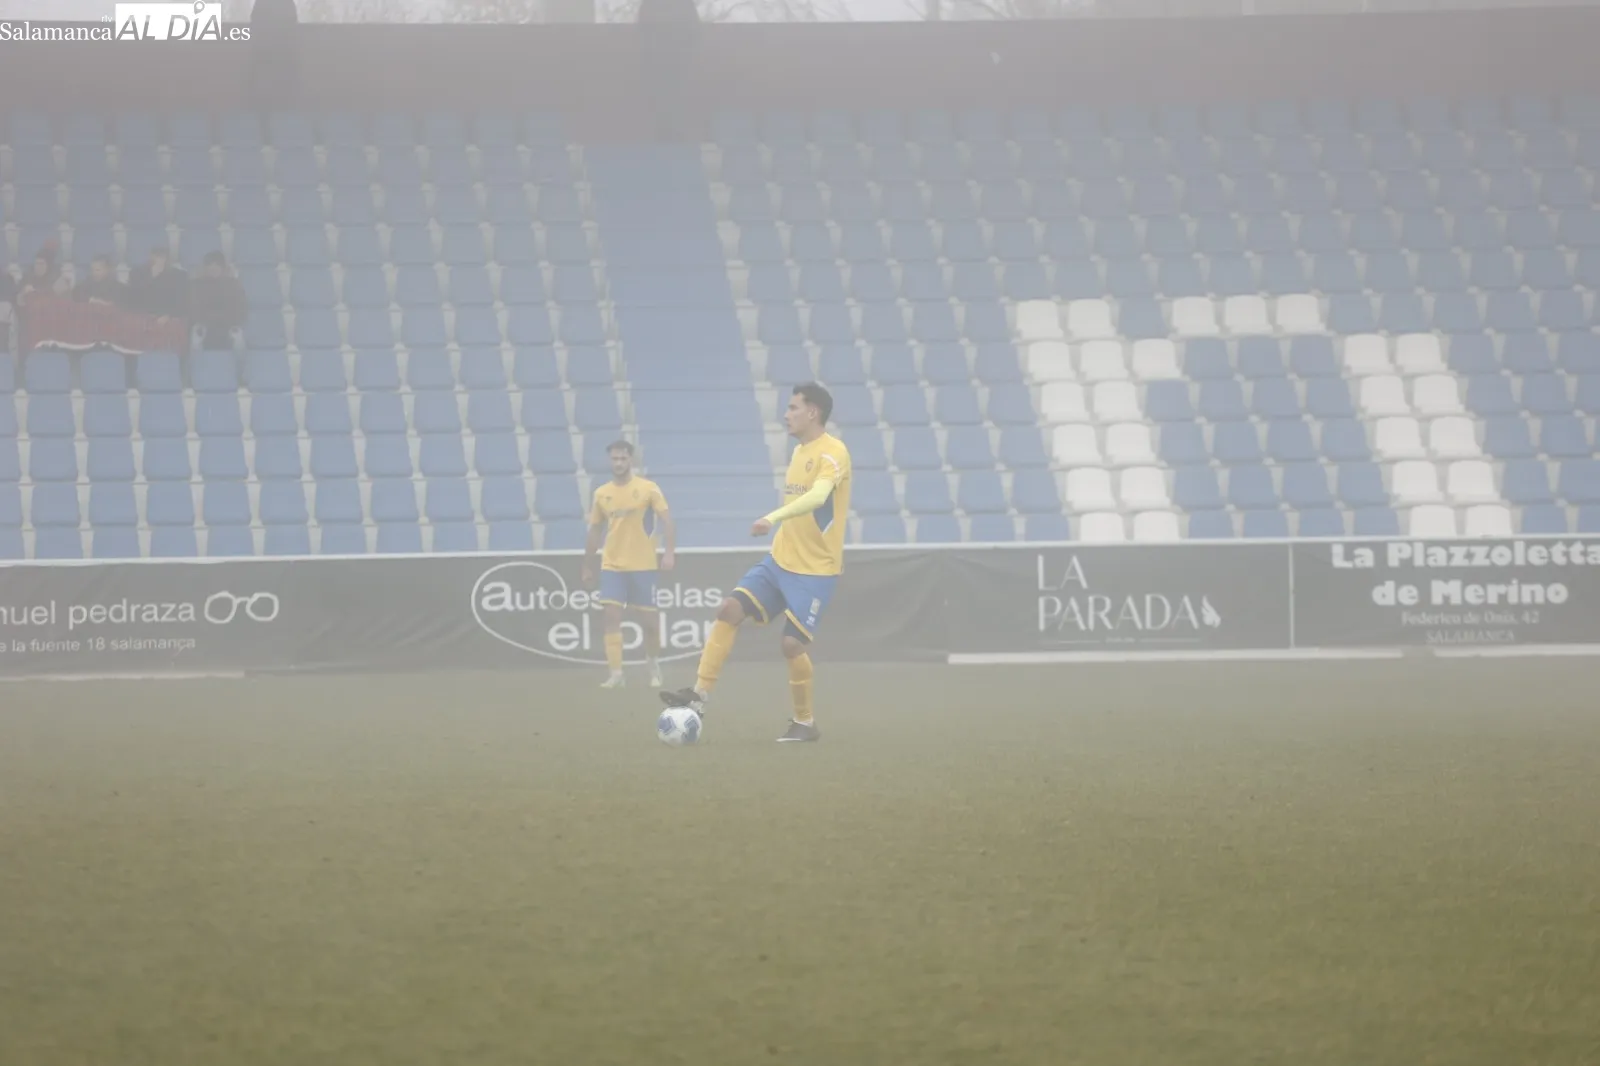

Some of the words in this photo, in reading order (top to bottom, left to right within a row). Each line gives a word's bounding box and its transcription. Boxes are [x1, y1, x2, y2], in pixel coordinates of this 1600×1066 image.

[1331, 543, 1375, 568] La
[1387, 540, 1600, 567] Plazzoletta
[1037, 554, 1088, 591] LA
[1371, 580, 1419, 606] de
[1431, 578, 1569, 605] Merino
[68, 598, 196, 631] pedraza
[1038, 594, 1199, 632] PARADA
[12, 639, 26, 652] la
[30, 638, 80, 652] fuente
[87, 636, 105, 650] 18
[110, 636, 196, 650] salamanca
[547, 612, 591, 651] el
[1425, 629, 1515, 643] SALAMANCA
